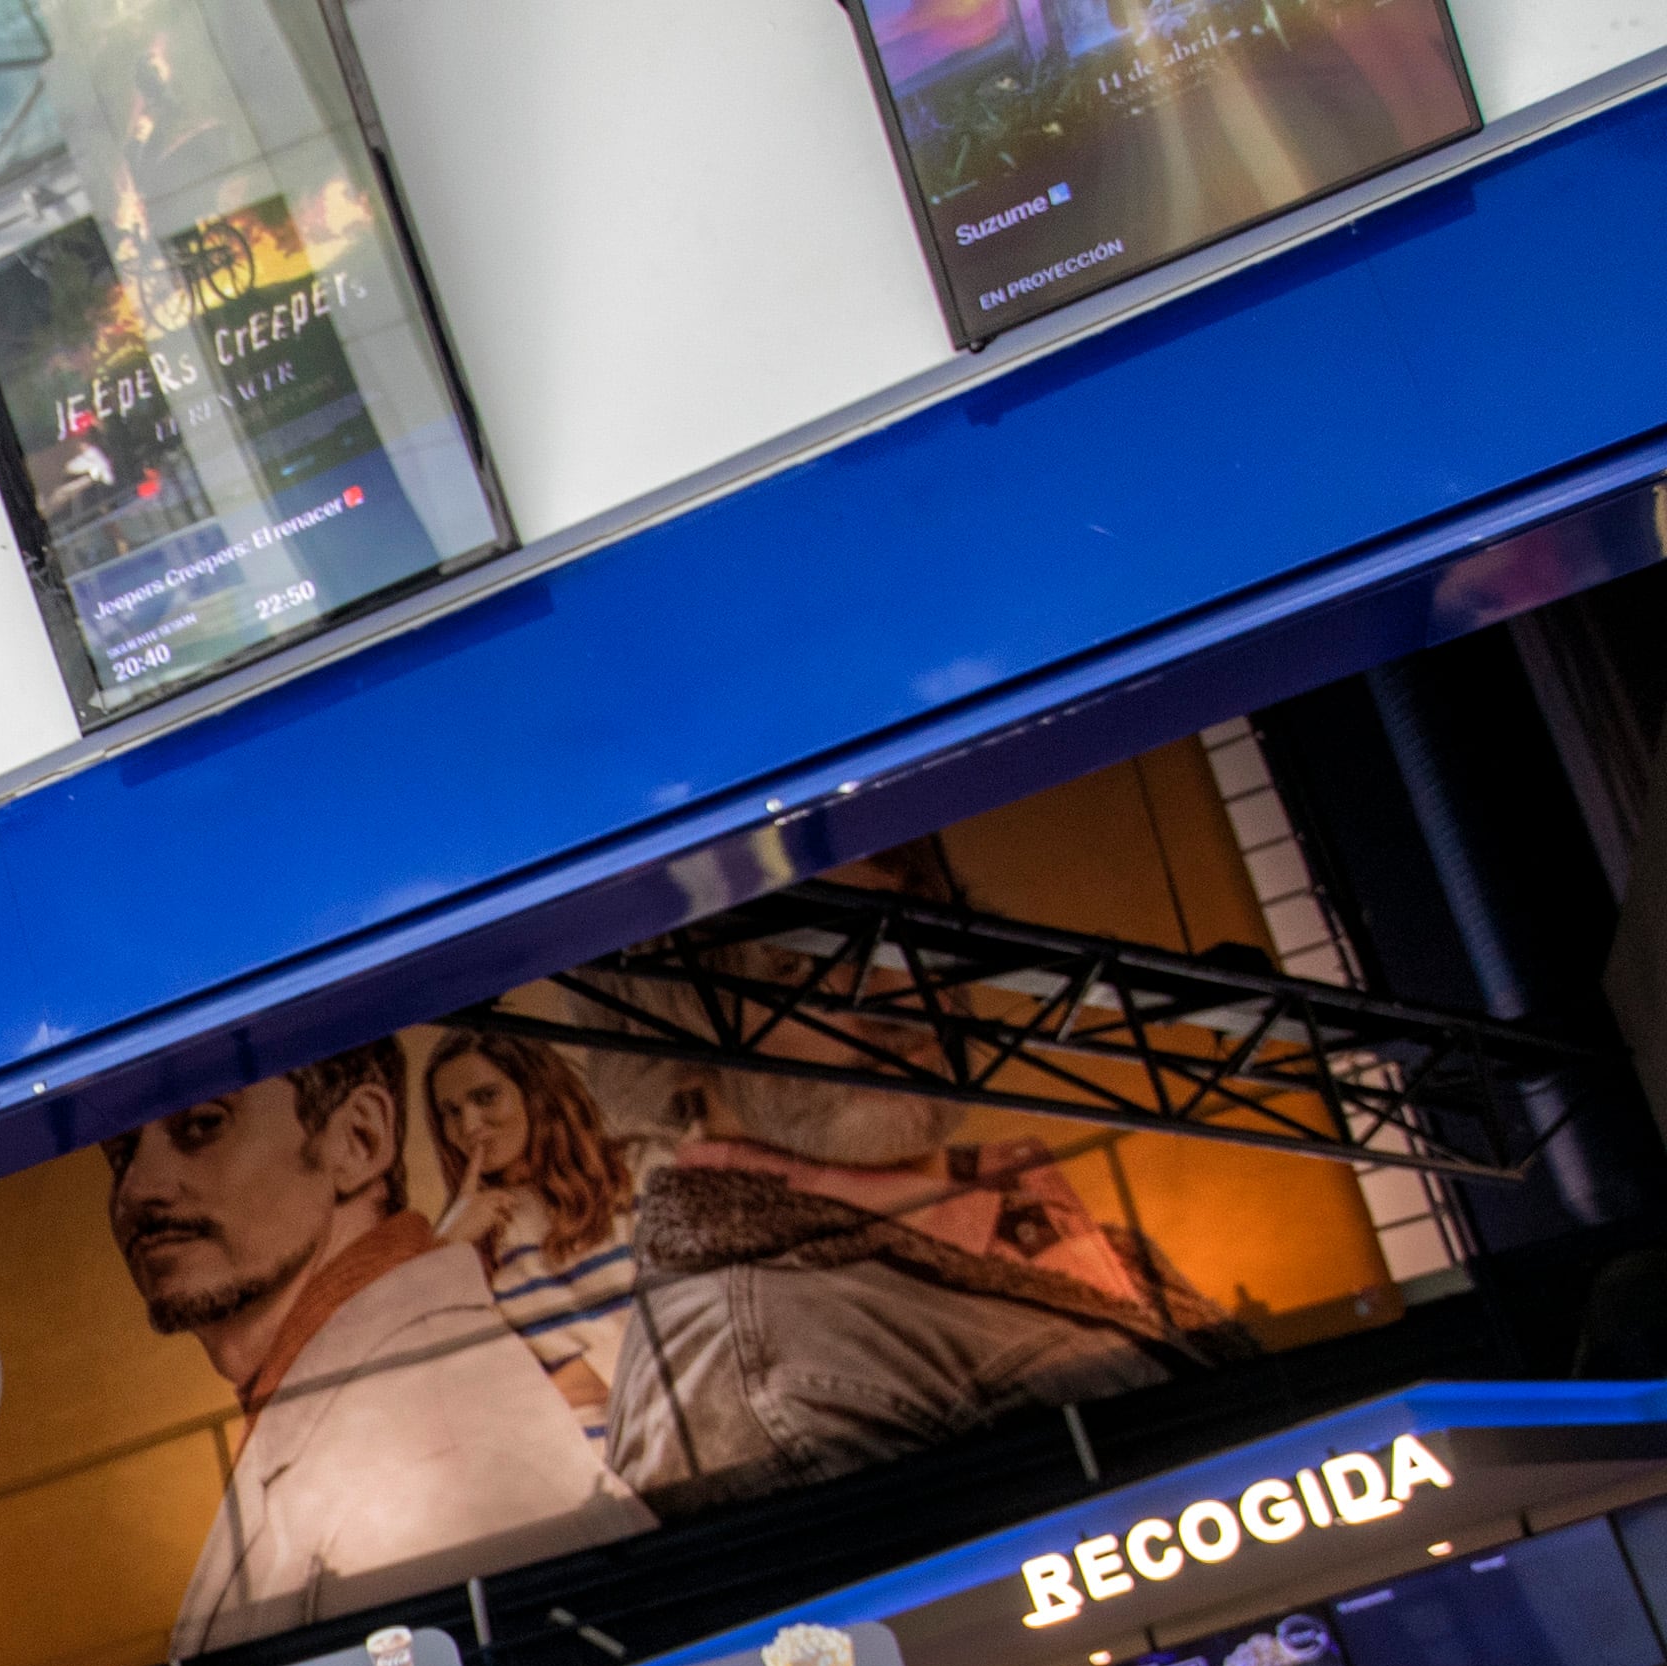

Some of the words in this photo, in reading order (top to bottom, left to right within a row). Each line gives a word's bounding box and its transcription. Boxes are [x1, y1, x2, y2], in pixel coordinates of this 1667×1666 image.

[955, 194, 1049, 246] Suzume
[979, 288, 1008, 311] EN
[1007, 237, 1124, 297] PROYECCIÓN
[94, 578, 166, 621] Jeepers
[274, 497, 345, 540] renacer
[254, 579, 317, 620] 22:50
[112, 643, 172, 682] 20:40
[1021, 1433, 1453, 1628] RECOGIDA
